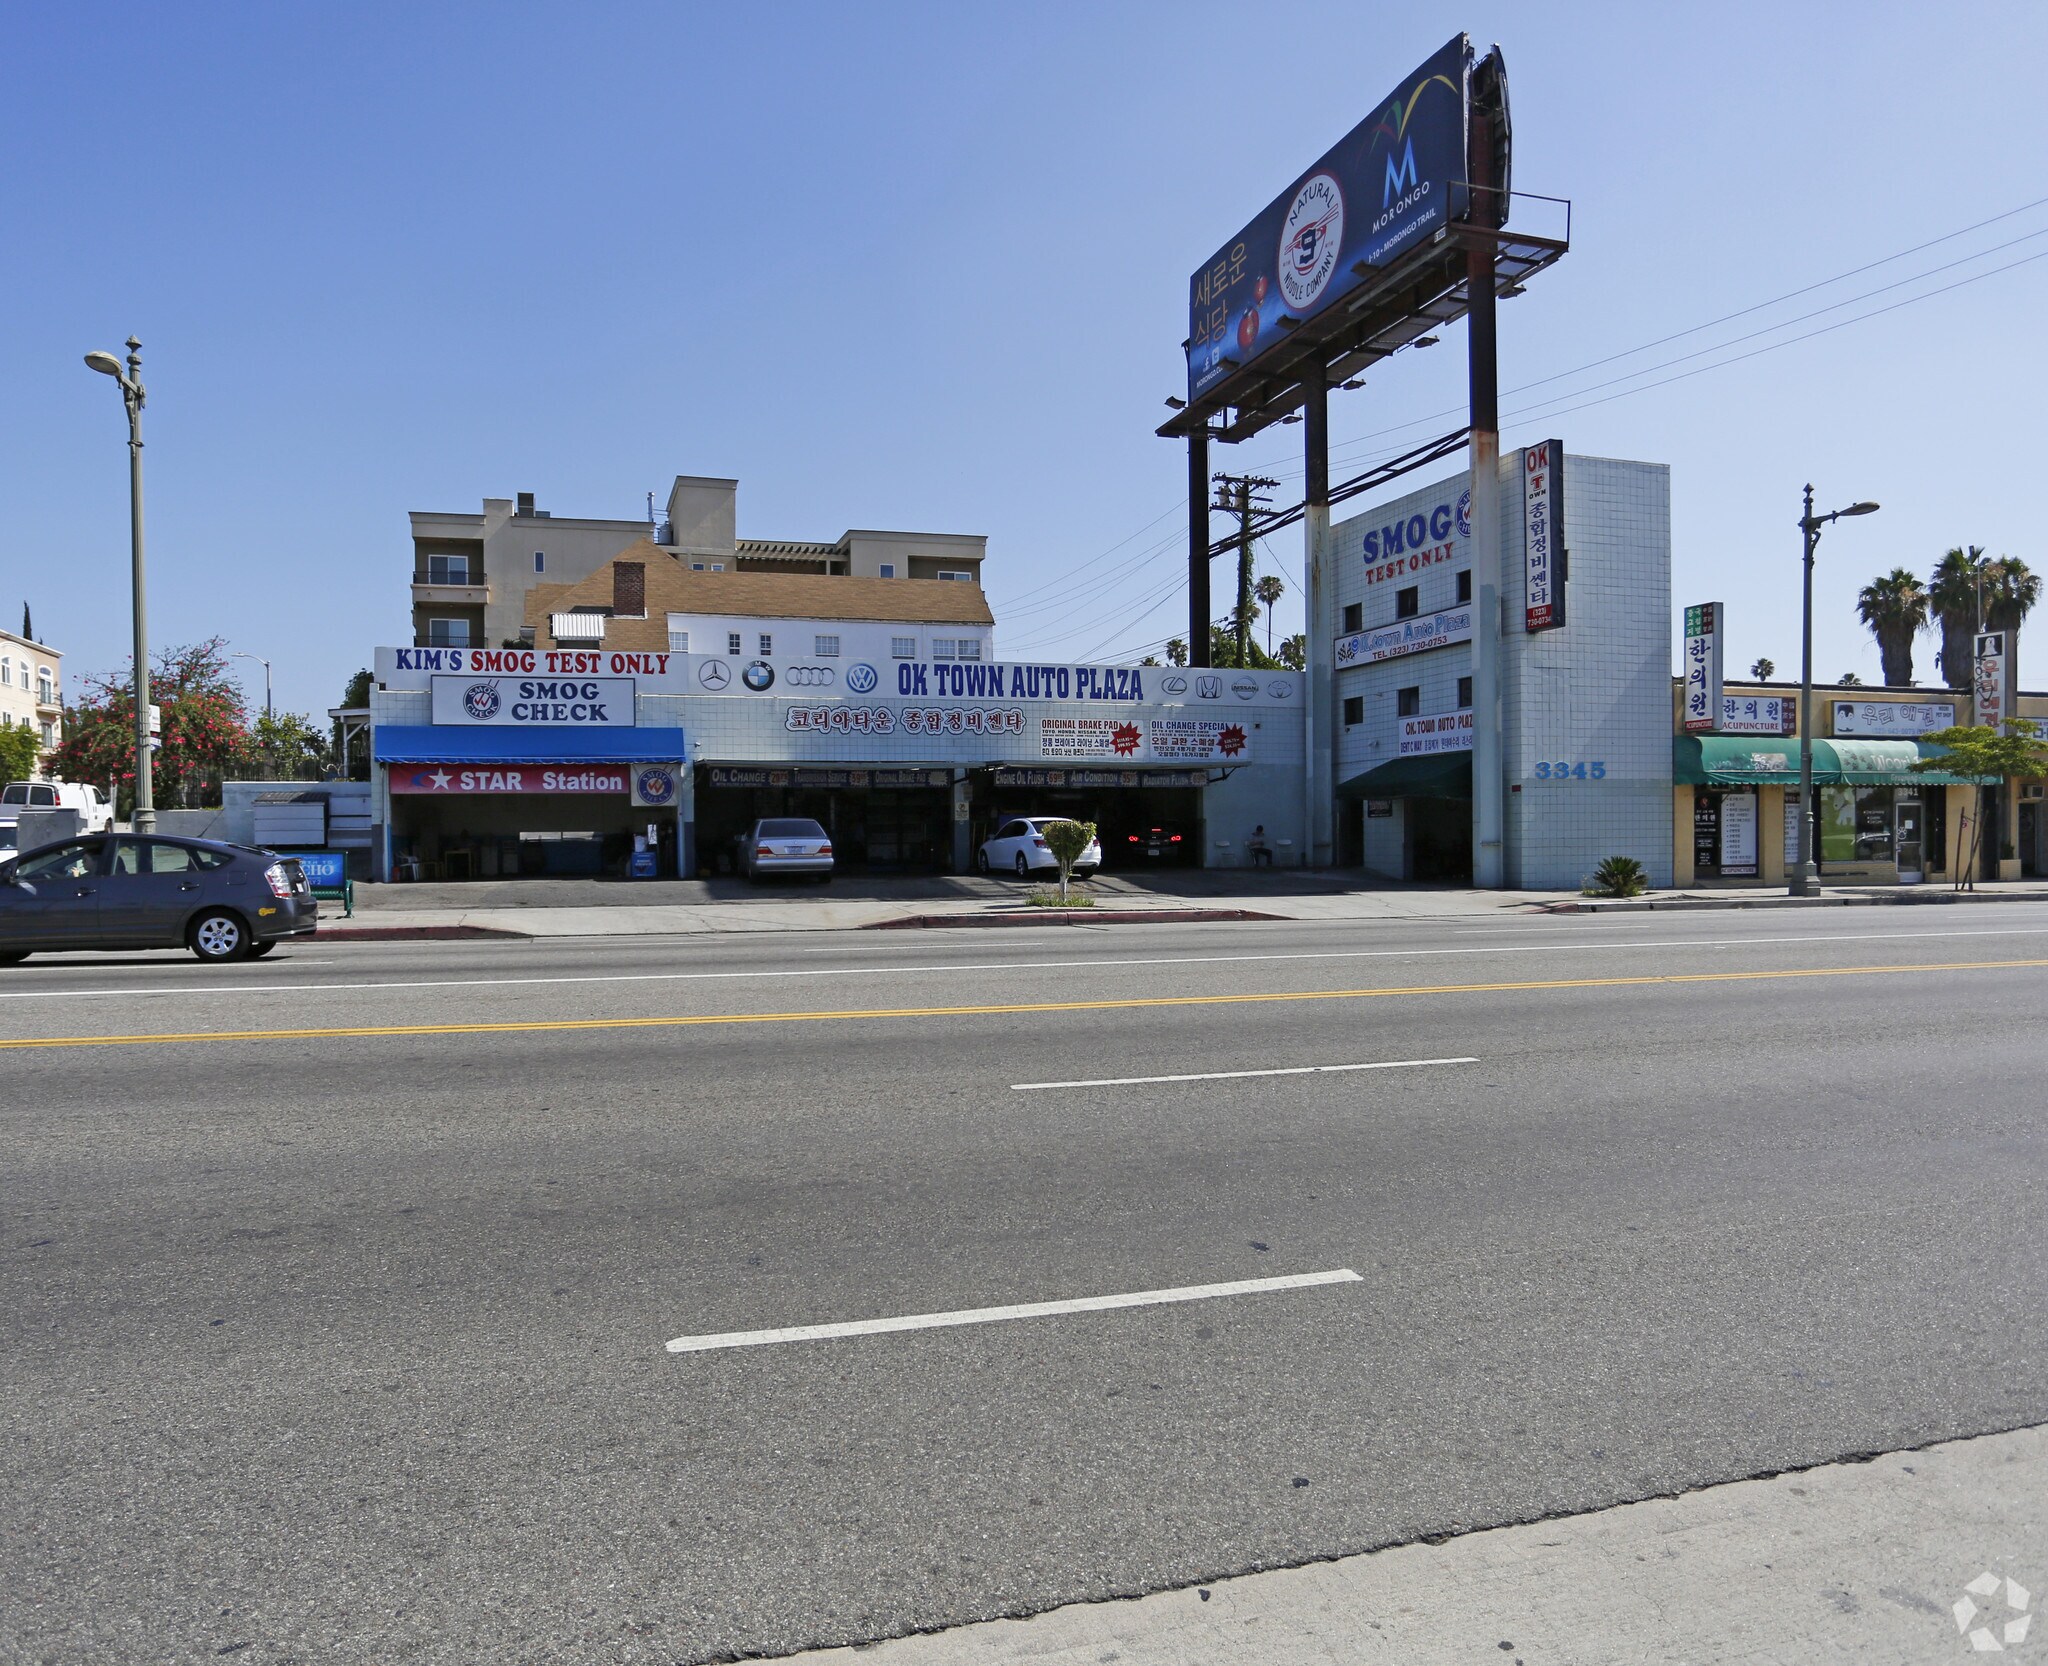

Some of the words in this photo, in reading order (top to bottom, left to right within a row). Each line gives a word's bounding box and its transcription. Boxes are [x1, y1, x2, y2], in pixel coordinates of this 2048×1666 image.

[1289, 182, 1335, 226] NATURAL
[1372, 181, 1430, 235] MORONGO
[1368, 248, 1380, 264] I-10
[1383, 221, 1418, 253] MORONGO
[1416, 207, 1437, 227] TRAIL
[1194, 242, 1247, 308] 새로운
[1283, 270, 1303, 300] NOODLE
[1305, 251, 1334, 298] COMPANY
[1194, 299, 1229, 348] 식당
[1527, 445, 1548, 472] OK
[1362, 503, 1453, 565] SMOG
[1365, 558, 1405, 585] TEST
[1409, 541, 1455, 571] ONLY
[1402, 622, 1434, 641] Auto
[1434, 613, 1470, 635] Plaza
[1372, 651, 1387, 660] TEL
[1389, 644, 1409, 657] (323)
[1411, 635, 1448, 651] 730-0753
[396, 648, 463, 671] KIM'S
[470, 651, 536, 673] SMOG
[545, 652, 602, 674] TEST
[610, 653, 670, 675] ONLY
[899, 662, 929, 696] OK
[934, 664, 1005, 699] TOWN
[1010, 666, 1069, 700] AUTO
[1076, 667, 1144, 701] PLAZA
[1688, 638, 1711, 717] 한의원
[468, 685, 497, 699] SMOG
[519, 681, 600, 700] SMOG
[466, 703, 498, 717] CHECK
[511, 703, 609, 721] CHECK
[791, 709, 894, 730] 코리아타운
[1861, 704, 1895, 726] 우리
[1899, 704, 1935, 727] 애견
[1042, 719, 1076, 729] ORIGINAL
[1078, 720, 1102, 730] BRAKE
[1104, 720, 1119, 730] PAD
[1152, 721, 1164, 729] OIL
[1166, 721, 1196, 730] CHANGE
[1438, 716, 1455, 732] AUTO
[1458, 713, 1472, 730] PLAZ
[1722, 722, 1780, 730] ACUPUNCTURE
[1055, 738, 1075, 747] 브레이크
[1077, 738, 1093, 748] 라이닝
[1151, 737, 1167, 746] 오일
[1171, 737, 1187, 746] 교환
[642, 771, 668, 782] SMOG
[712, 769, 727, 782] OIL
[730, 769, 766, 783] CHANGE
[995, 771, 1015, 785] ENGINE
[1017, 771, 1026, 785] OIL
[1027, 771, 1044, 785] FLUSH
[1071, 771, 1082, 782] AIR
[1084, 771, 1118, 783] CONDITION
[1534, 760, 1606, 780] 3345
[460, 771, 522, 791] STAR
[542, 771, 622, 791] Station
